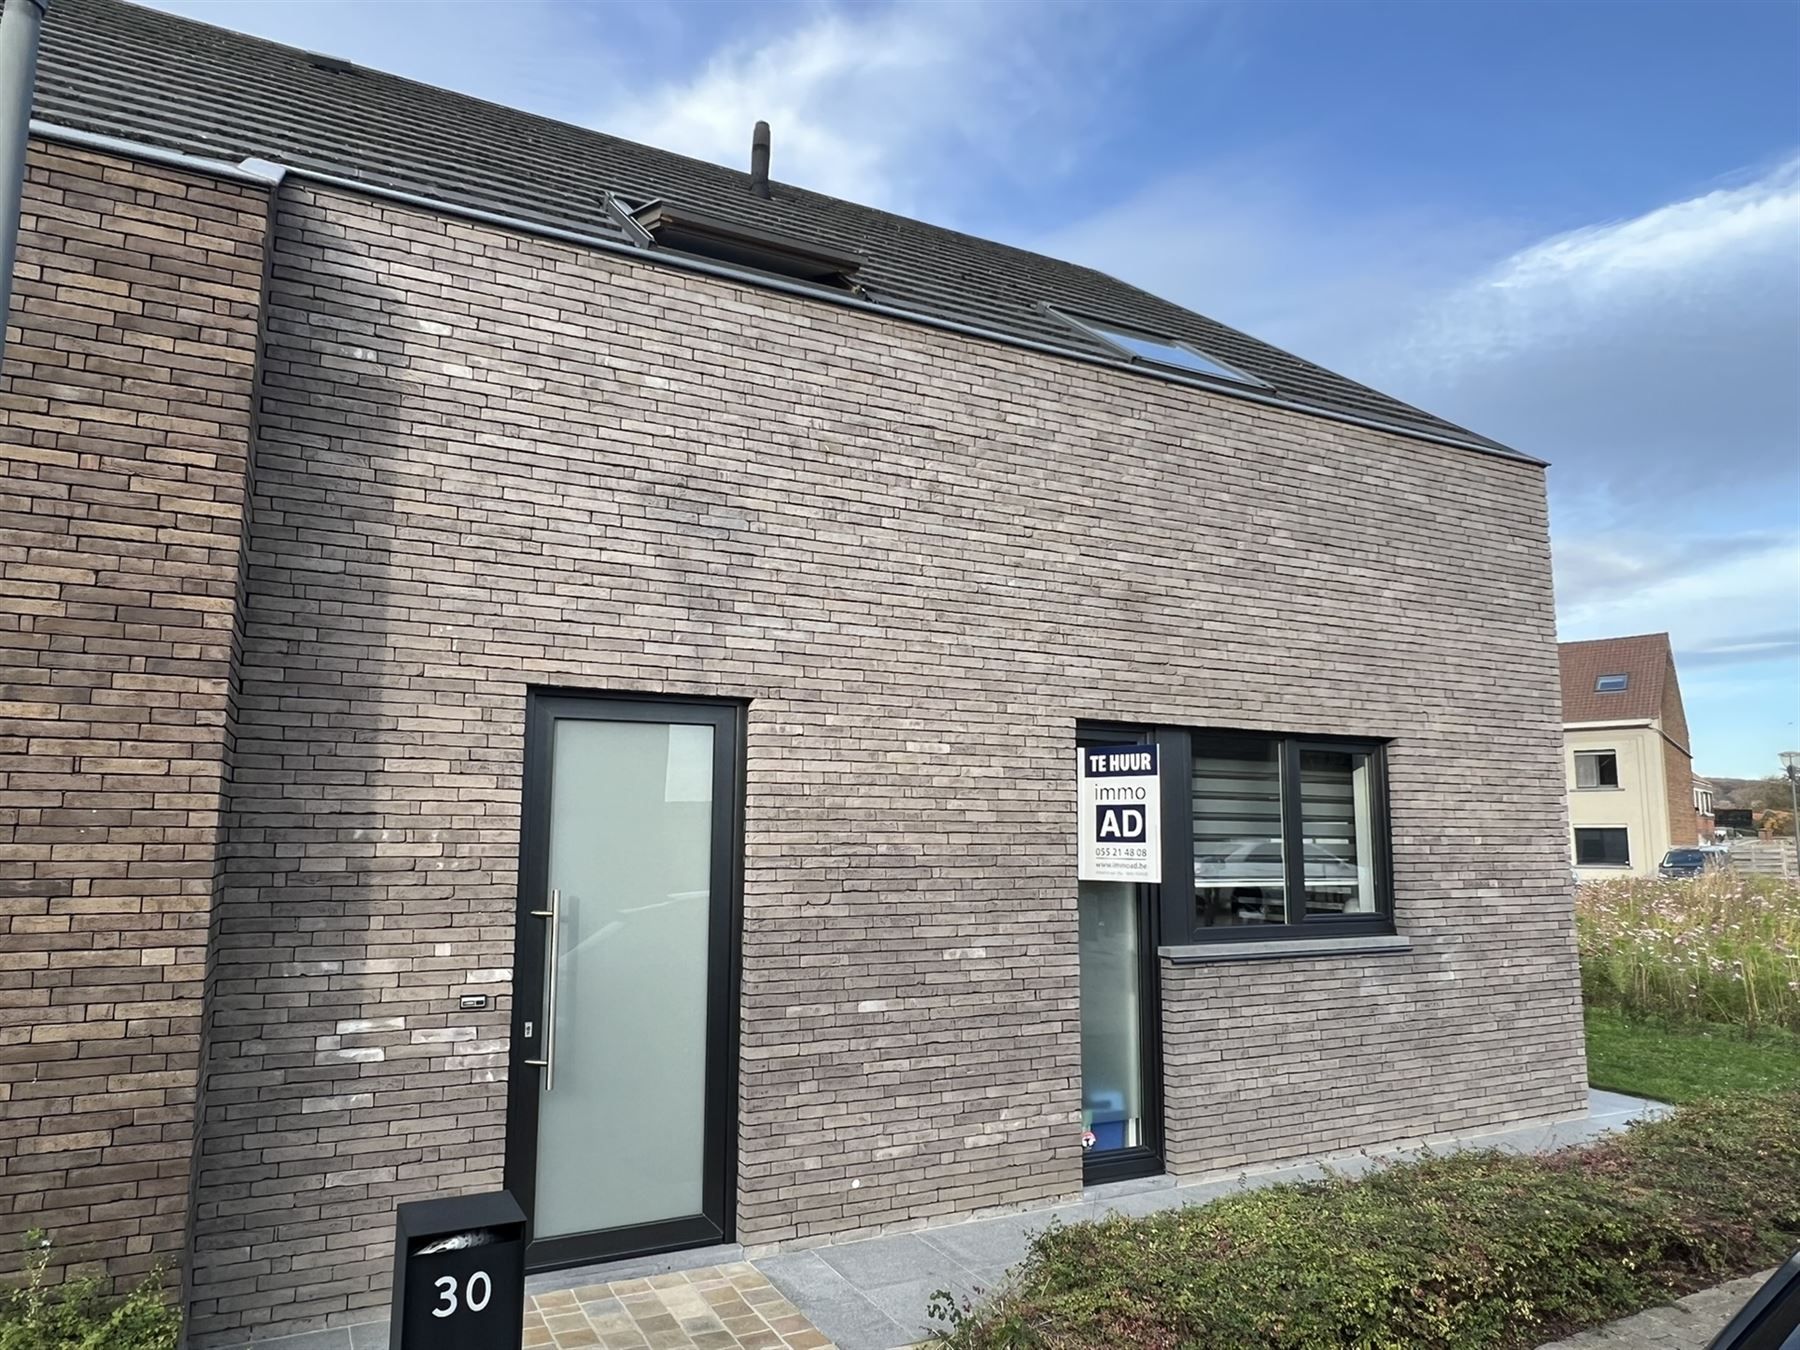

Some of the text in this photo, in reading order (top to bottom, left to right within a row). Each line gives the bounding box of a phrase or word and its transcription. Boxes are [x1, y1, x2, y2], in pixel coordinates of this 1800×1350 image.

[1089, 753, 1152, 772] TE HUUR
[1095, 784, 1146, 801] immo
[1099, 809, 1144, 838] AD
[1095, 847, 1147, 858] 055 21 48 08
[431, 1271, 492, 1318] 30
